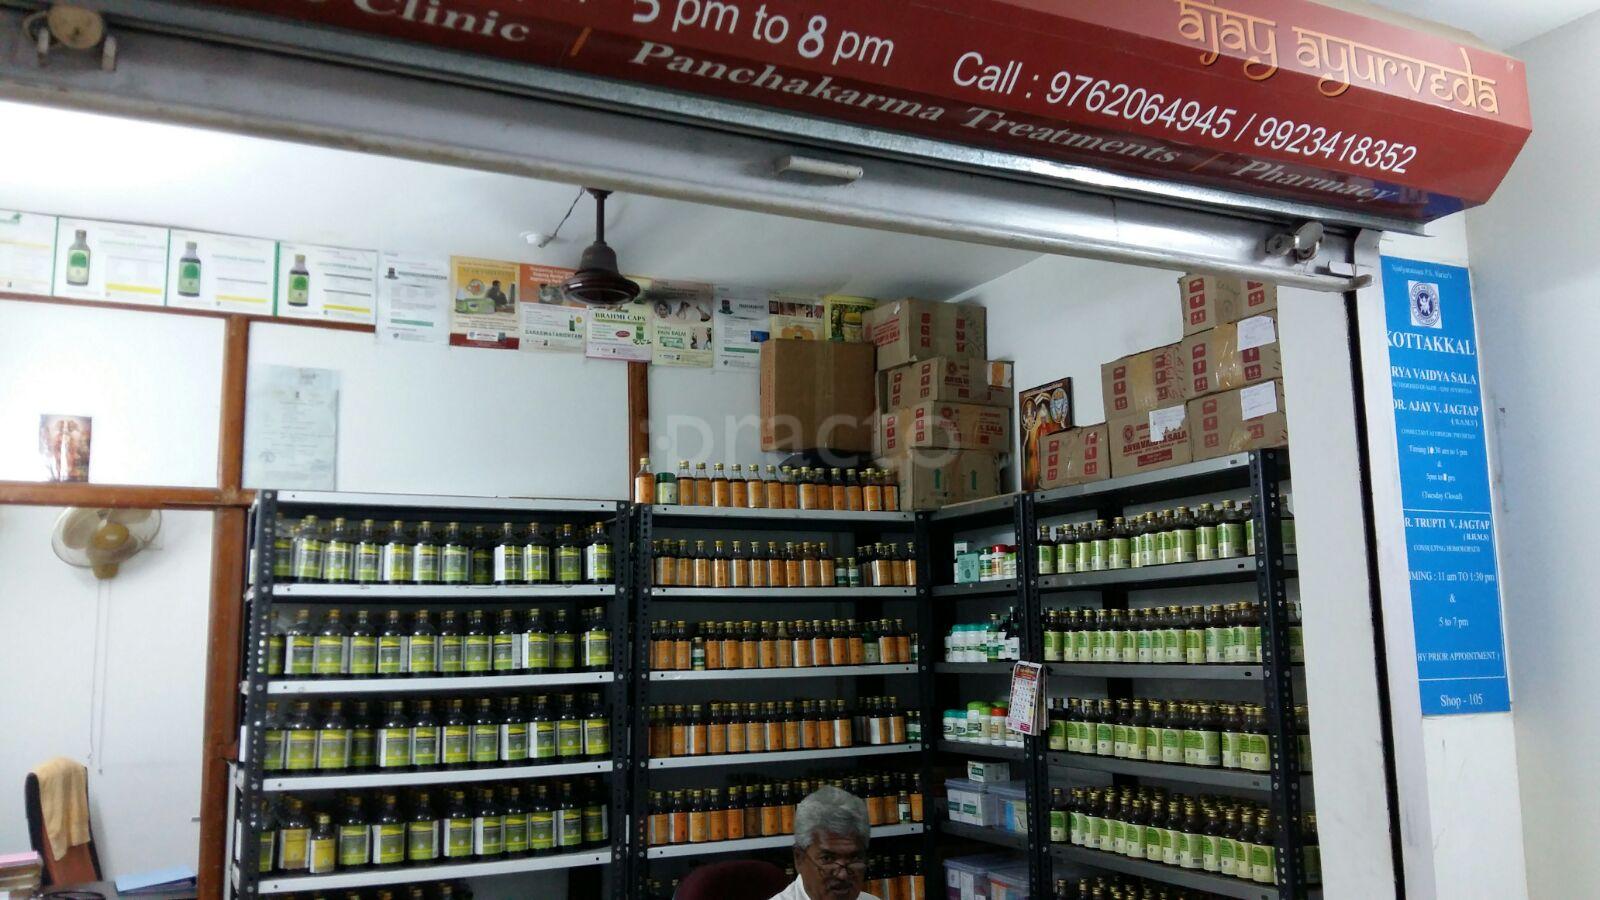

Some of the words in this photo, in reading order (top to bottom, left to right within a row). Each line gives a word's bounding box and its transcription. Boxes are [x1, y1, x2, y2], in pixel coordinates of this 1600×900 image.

[1291, 26, 1500, 115] ayurveda
[671, 0, 740, 34] pm
[751, 13, 789, 45] to
[797, 14, 829, 59] 8
[831, 29, 895, 68] pm
[952, 51, 1023, 95] Call
[1045, 70, 1238, 140] 9762064945
[1254, 116, 1419, 175] 9923418352
[353, 0, 530, 42] Clinic
[628, 40, 947, 122] Panchakarma
[959, 106, 1182, 164] Treatments
[1234, 159, 1402, 203] Pharmacy
[1386, 331, 1475, 356] KOTTAKKAL
[1391, 366, 1412, 379] RYA
[1412, 368, 1450, 382] VAIDYA
[1451, 372, 1477, 385] SALA
[1409, 401, 1432, 412] AJAY
[1443, 404, 1479, 416] JAGTAP
[1404, 517, 1413, 528] R.
[1415, 518, 1446, 529] TRUPTI
[1459, 519, 1490, 530] JAGTAP
[1457, 571, 1469, 581] TO
[1449, 593, 1456, 603] &
[1458, 619, 1469, 629] pm
[1428, 652, 1449, 661] PRIOR
[1449, 651, 1496, 661] APPOINTMENT
[1440, 694, 1461, 709] Shop
[1469, 693, 1483, 705] 105
